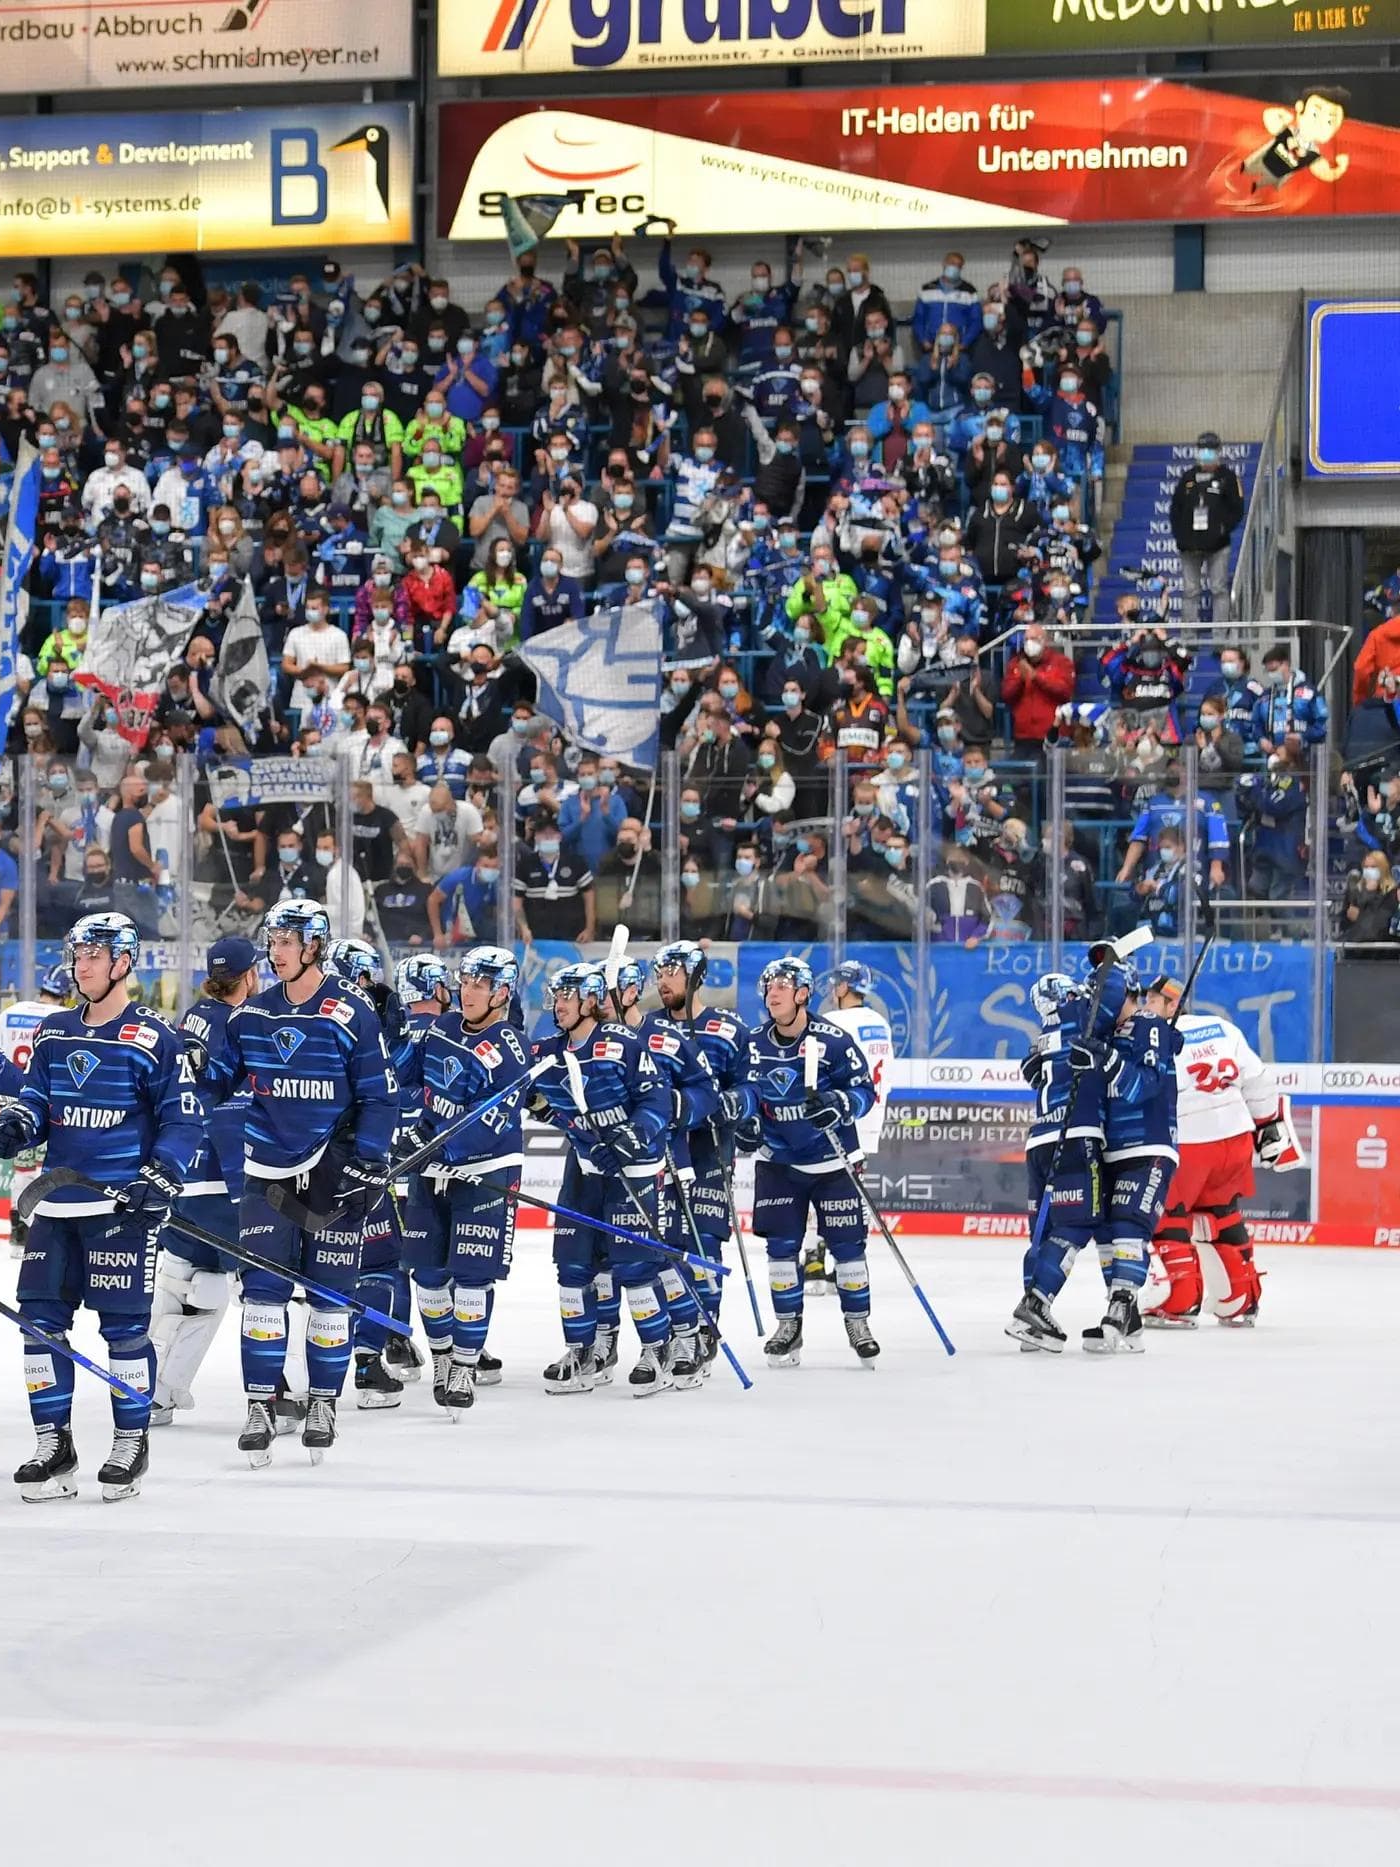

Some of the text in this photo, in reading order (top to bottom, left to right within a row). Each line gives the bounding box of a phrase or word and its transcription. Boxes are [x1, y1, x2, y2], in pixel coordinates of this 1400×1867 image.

[94, 14, 202, 37] Abbruch
[1317, 8, 1346, 29] LIEBE
[116, 47, 379, 72] www.schmidmeyer.net
[638, 46, 924, 63] Siemensstr. 7 Gaimersheim
[841, 104, 1034, 136] IT-Helden für
[9, 146, 90, 170] Support
[96, 143, 113, 164] &
[119, 140, 254, 164] Development
[978, 143, 1187, 173] Unternehmen
[981, 1068, 1022, 1082] Aud
[1186, 1058, 1240, 1094] 32
[272, 1078, 335, 1100] SATURN
[63, 1106, 127, 1129] SATURN
[916, 1107, 952, 1121] DEN
[958, 1106, 1004, 1123] PUCK
[930, 1126, 973, 1141] DICH
[979, 1127, 1028, 1143] JETZT
[825, 1215, 858, 1228] BRÄU
[314, 1229, 360, 1247] HERRN
[456, 1223, 500, 1240] HERRN
[501, 1206, 516, 1266] SATURN
[88, 1250, 137, 1268] HERRN
[316, 1250, 355, 1267] BRÄU
[457, 1242, 493, 1258] BRÄU
[90, 1274, 132, 1290] BRÄU
